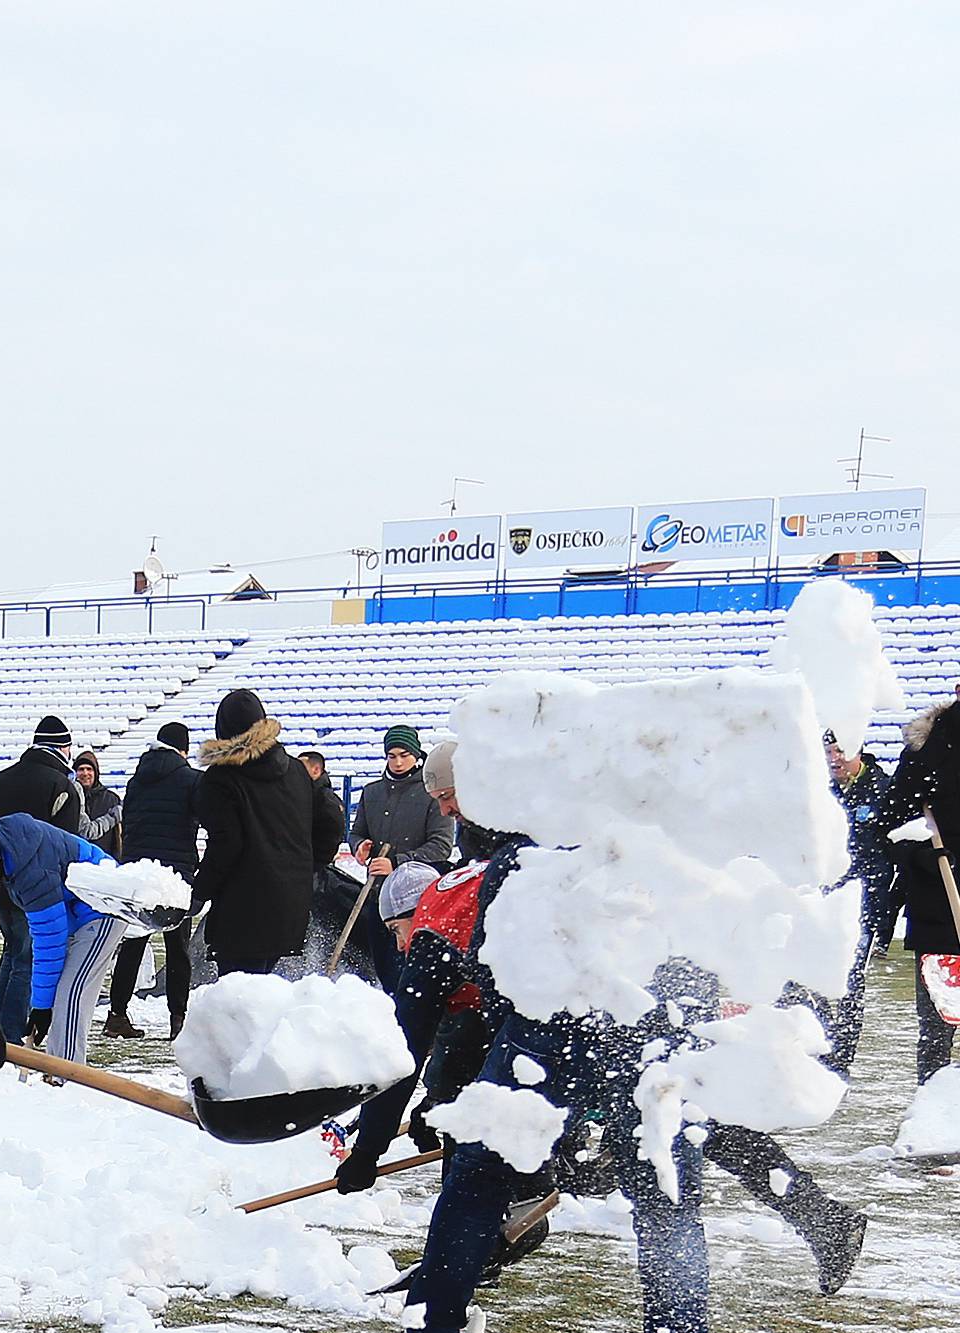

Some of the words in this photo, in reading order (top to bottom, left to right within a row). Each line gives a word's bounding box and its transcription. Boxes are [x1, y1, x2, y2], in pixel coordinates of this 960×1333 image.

[807, 508, 922, 524] LIPAPROMET
[807, 522, 920, 537] SLAVONIJA
[385, 533, 495, 565] marinada
[536, 530, 604, 552] OSJEČKO
